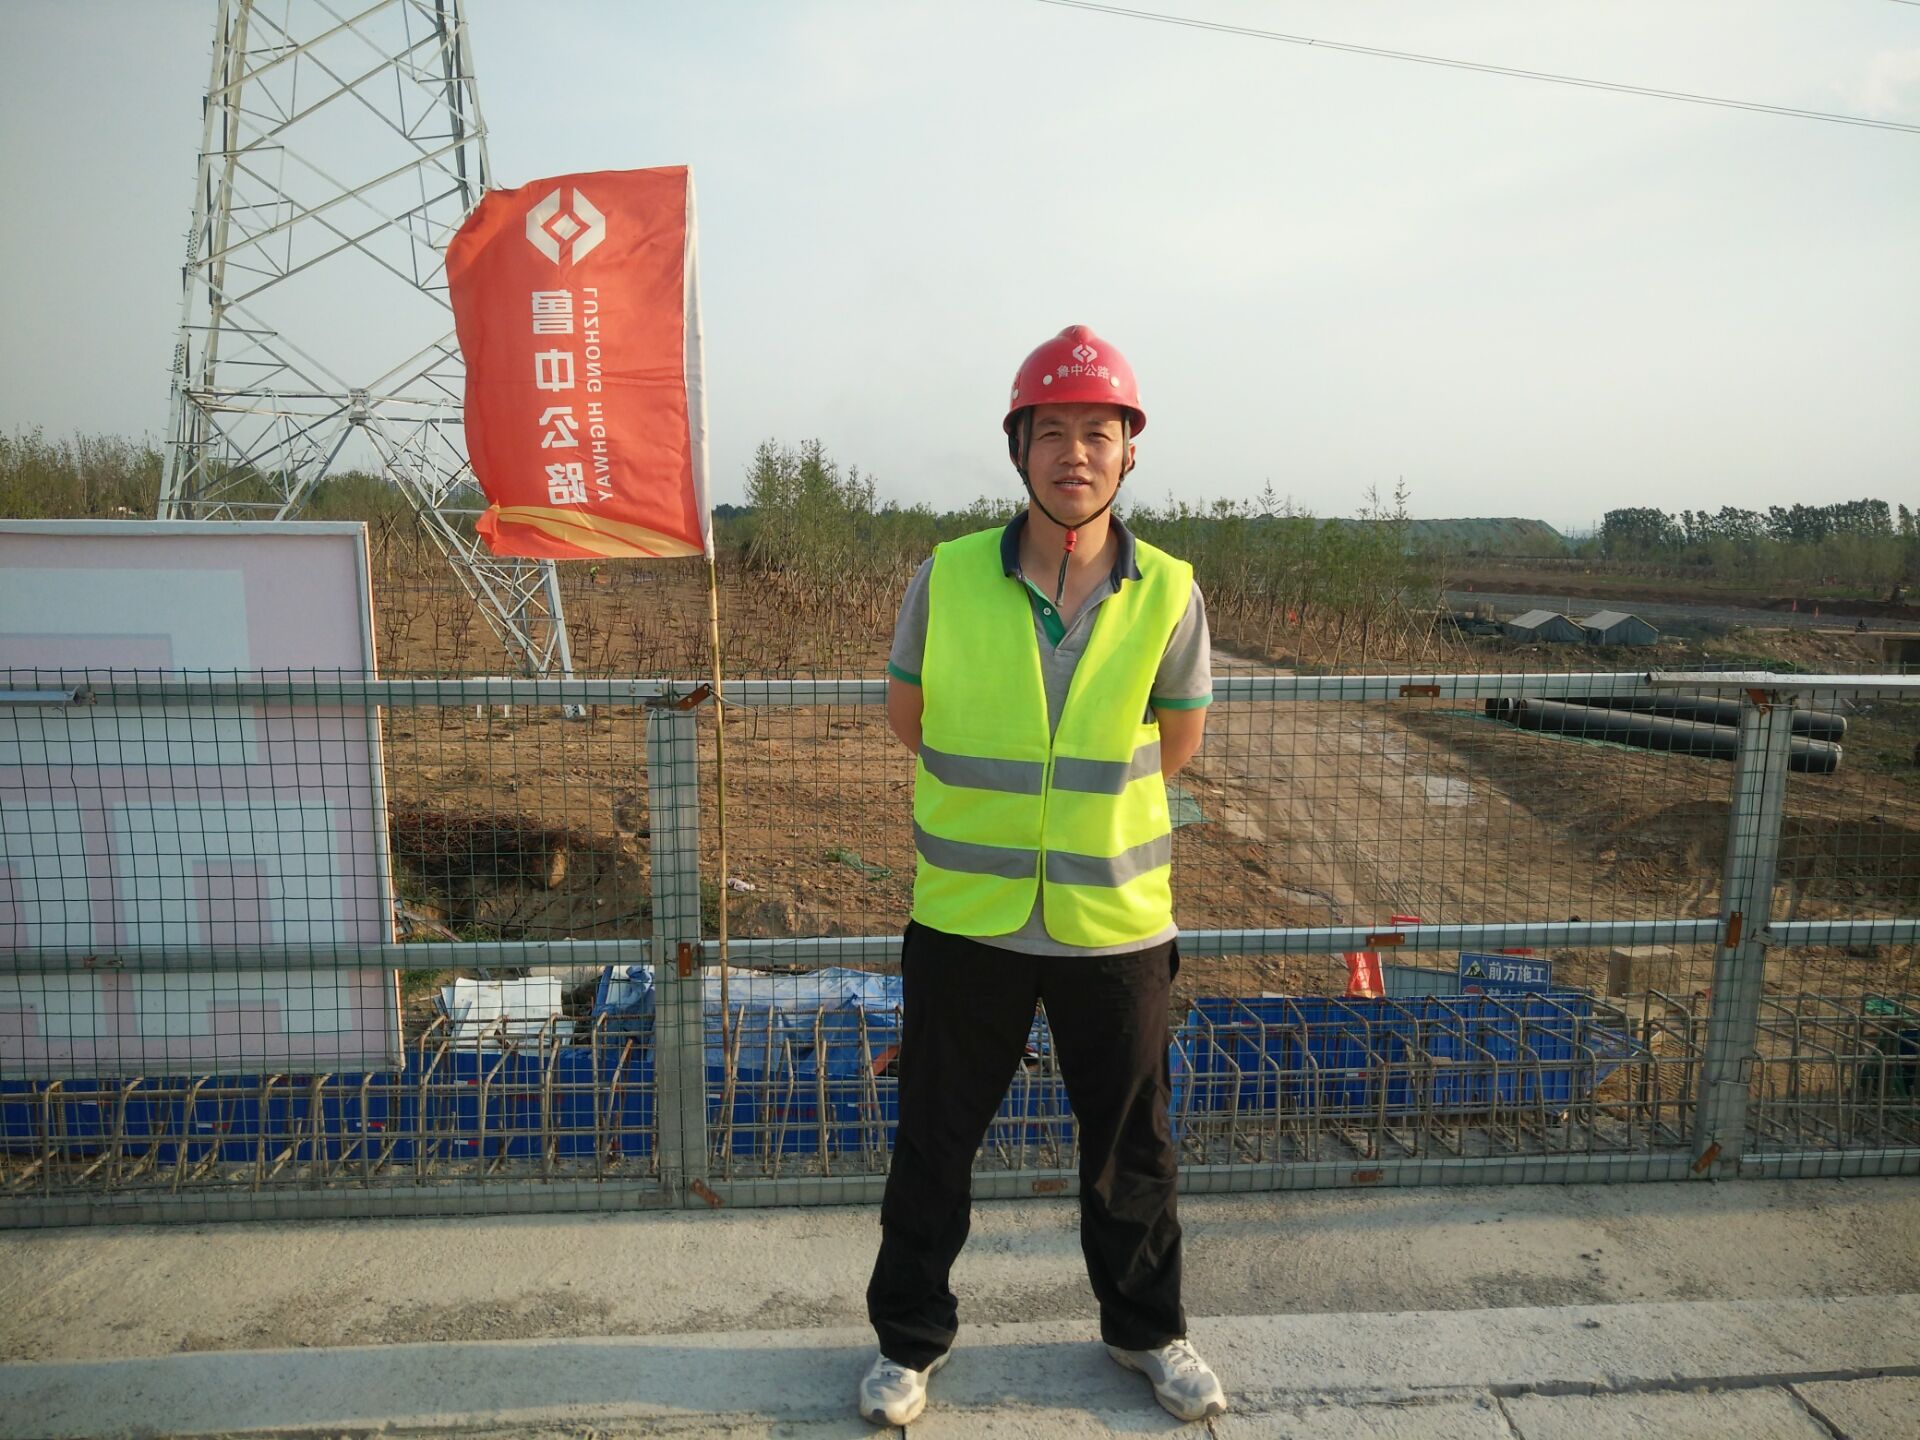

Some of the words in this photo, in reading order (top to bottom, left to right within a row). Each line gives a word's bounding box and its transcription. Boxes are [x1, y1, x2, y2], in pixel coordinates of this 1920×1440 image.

[1056, 363, 1111, 380] 鲁中公路
[1488, 961, 1545, 983] 前方施工
